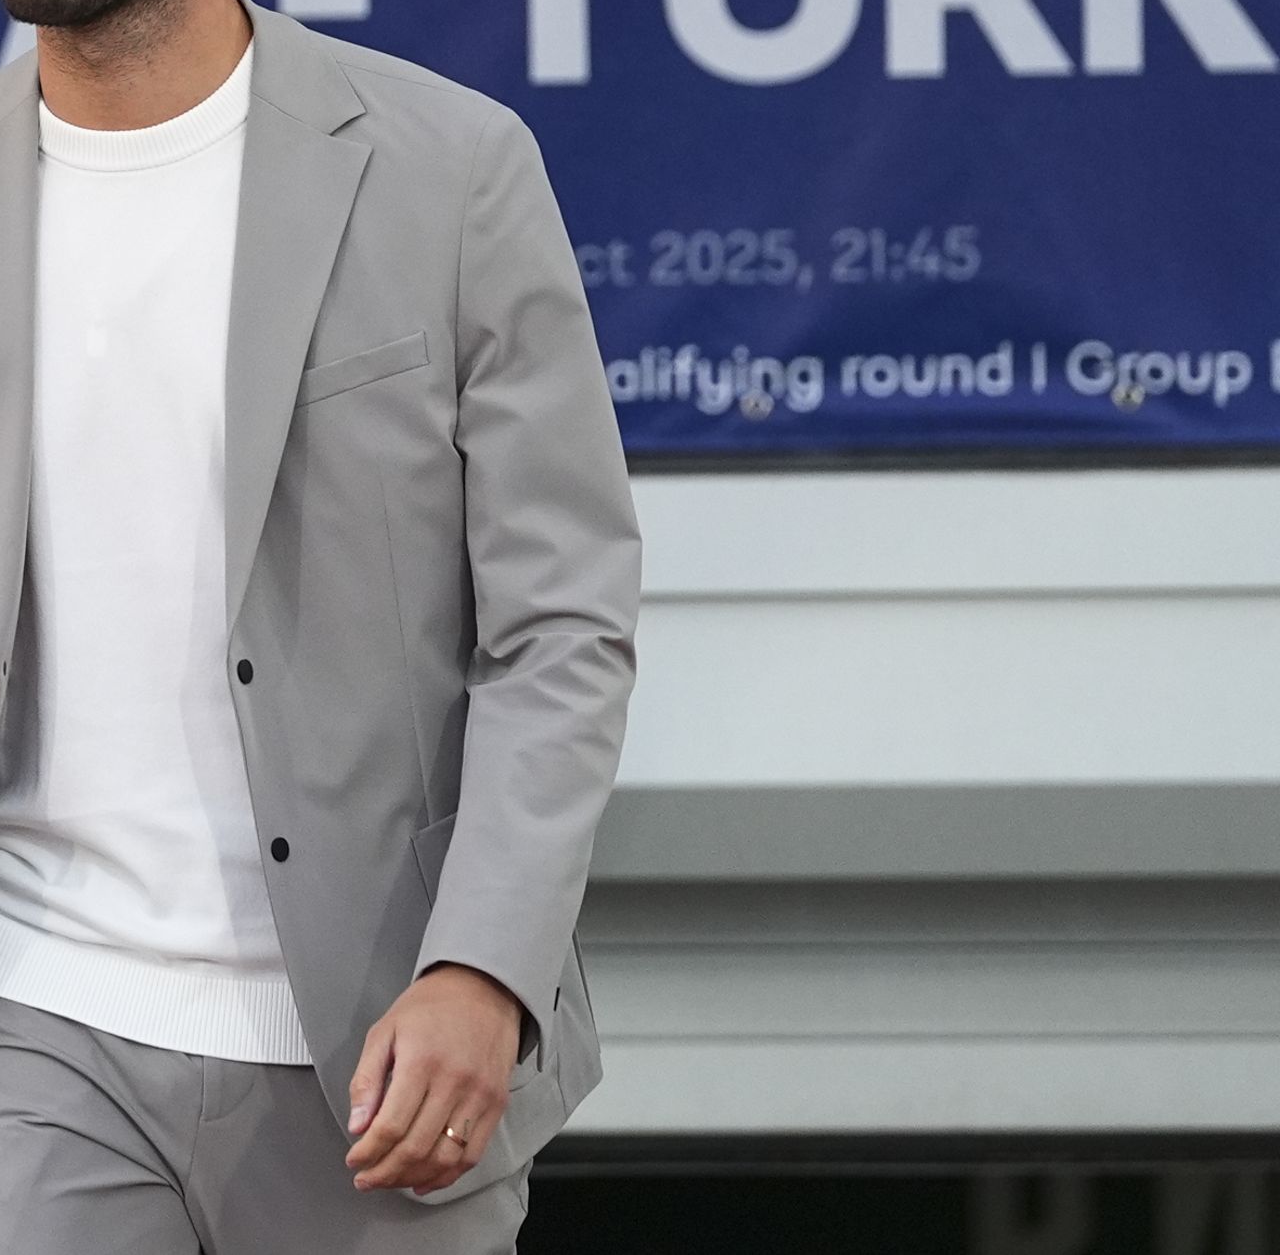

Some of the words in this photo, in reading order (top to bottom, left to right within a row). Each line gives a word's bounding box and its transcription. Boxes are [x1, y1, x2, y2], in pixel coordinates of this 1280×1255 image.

[649, 228, 814, 293] 2025,
[831, 225, 982, 283] 21:45
[841, 339, 1013, 399] round
[1065, 339, 1254, 409] Group
